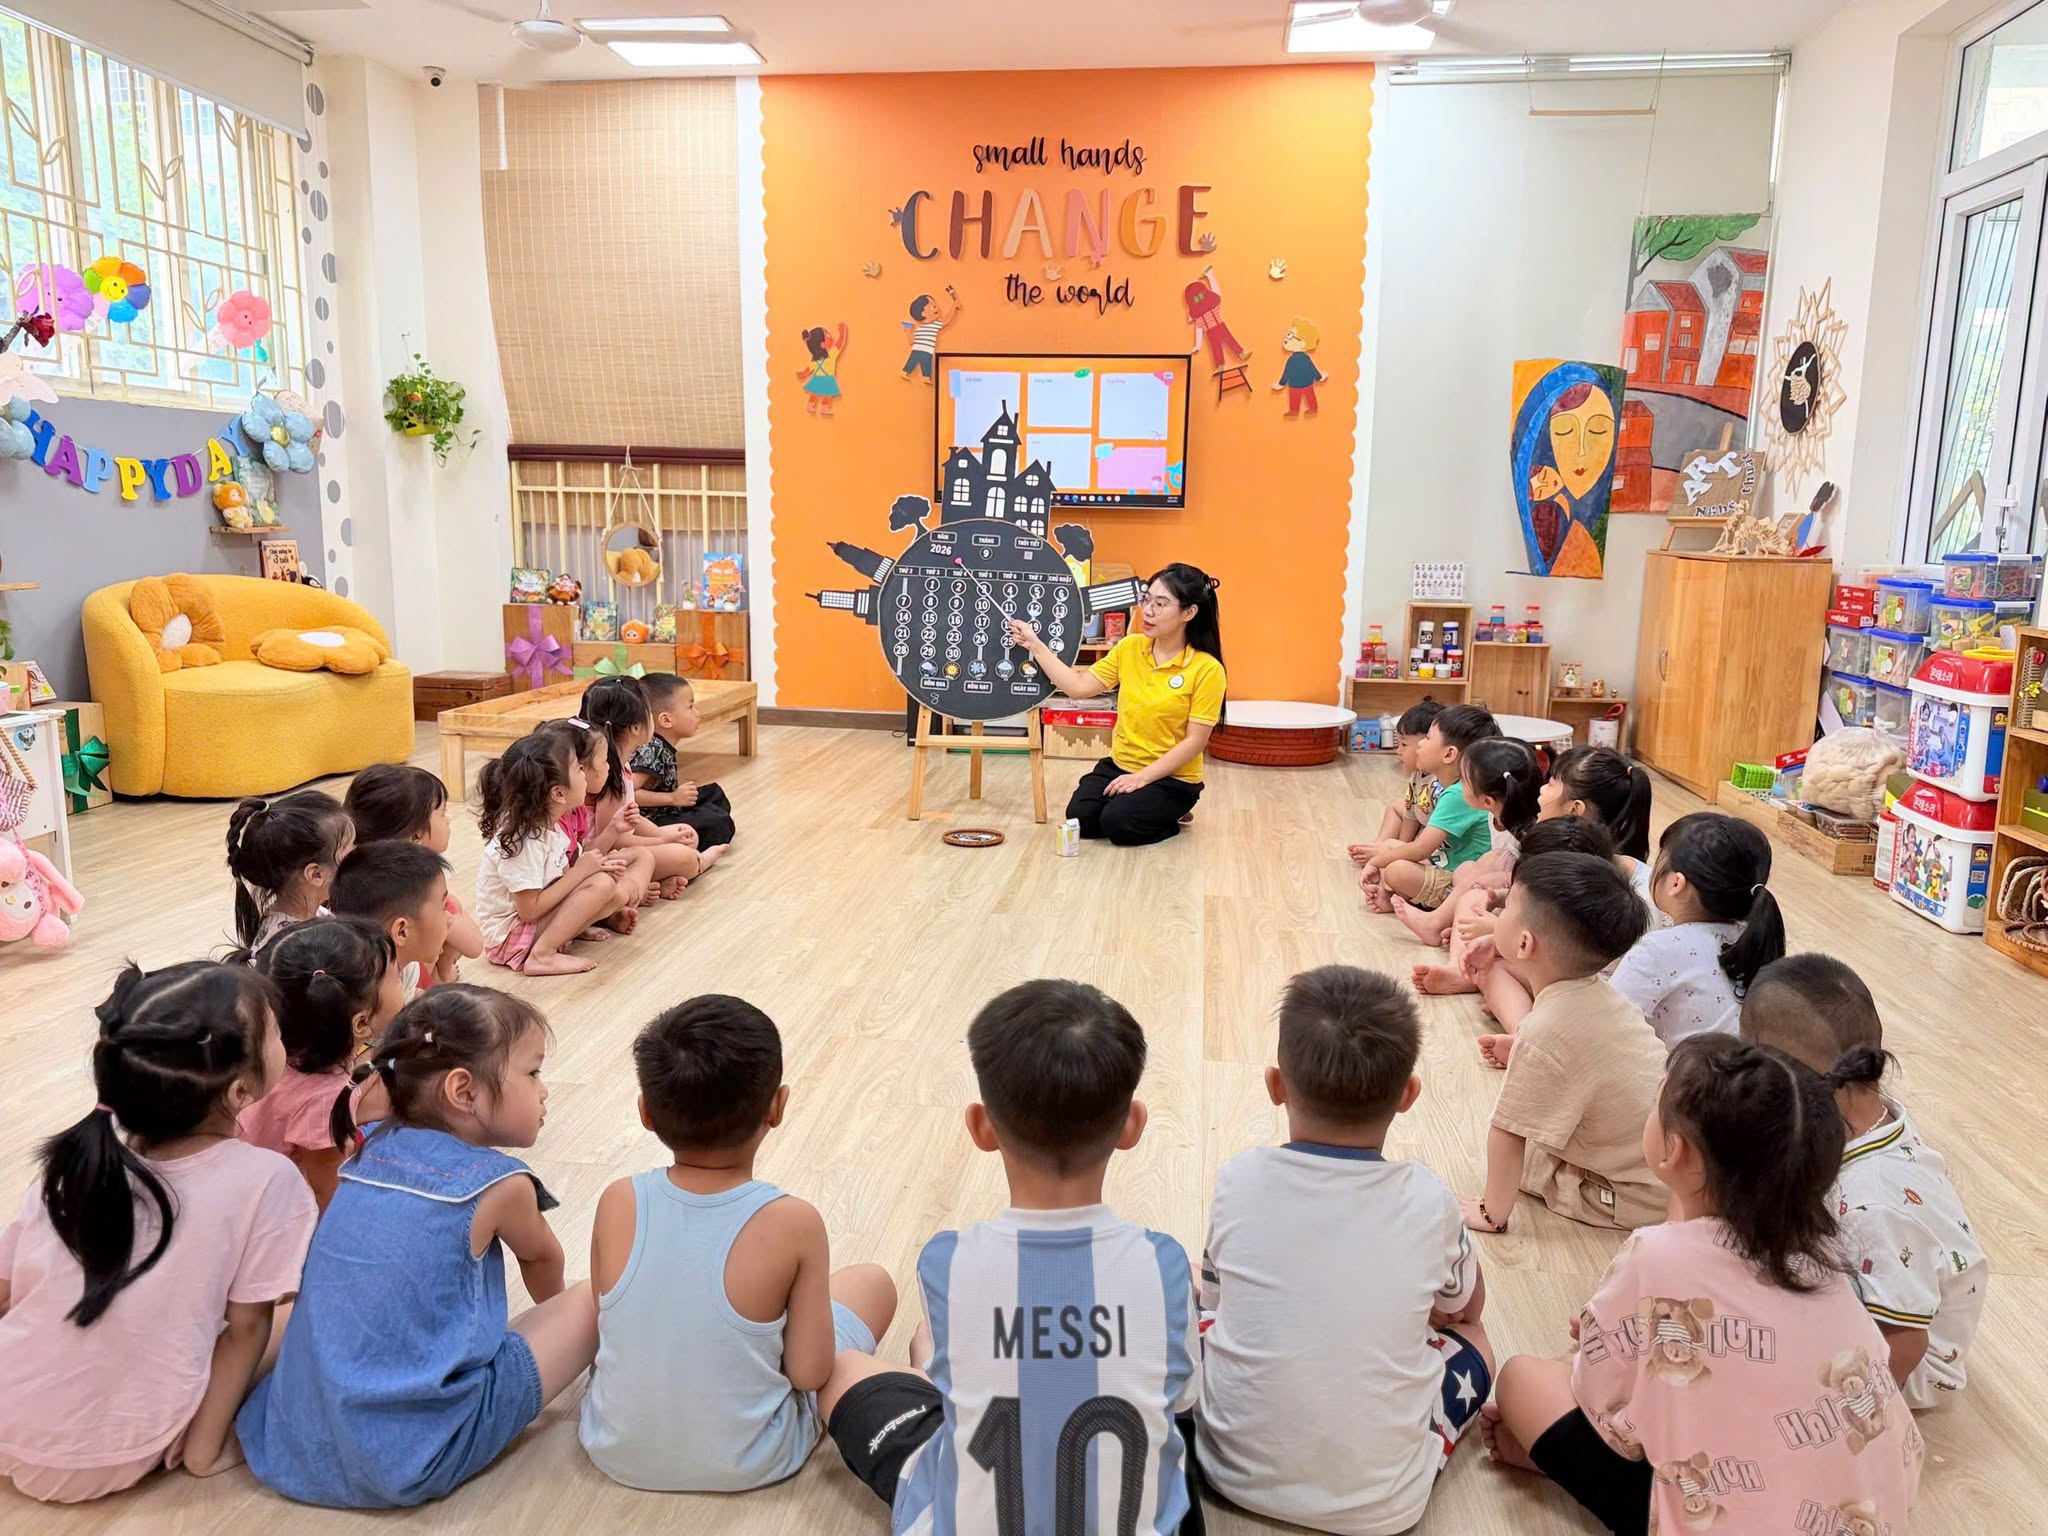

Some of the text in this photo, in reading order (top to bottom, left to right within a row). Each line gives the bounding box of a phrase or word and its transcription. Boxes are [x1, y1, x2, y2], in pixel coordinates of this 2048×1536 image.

[973, 136, 1147, 175] small hands
[900, 185, 1212, 260] CHANGE
[1004, 273, 1135, 316] the world
[1683, 451, 1742, 506] ART
[274, 554, 278, 564] 3
[930, 544, 952, 555] 2026
[983, 549, 989, 558] 9
[978, 601, 987, 609] 10
[1004, 603, 1014, 611] 11
[1030, 604, 1040, 612] 12
[1056, 606, 1065, 615] 13
[899, 613, 909, 621] 14
[925, 613, 934, 622] 15
[951, 616, 960, 624] 16
[977, 618, 987, 626] 17
[1051, 625, 1061, 634] 20
[898, 629, 907, 637] 21
[924, 631, 933, 639] 22
[949, 633, 959, 641] 23
[976, 635, 985, 643] 24
[1004, 637, 1013, 646] 25
[1421, 632, 1432, 642] 50
[896, 645, 958, 657] 28 29 30
[993, 1305, 1127, 1360] MESSI
[966, 1395, 1149, 1536] 10
